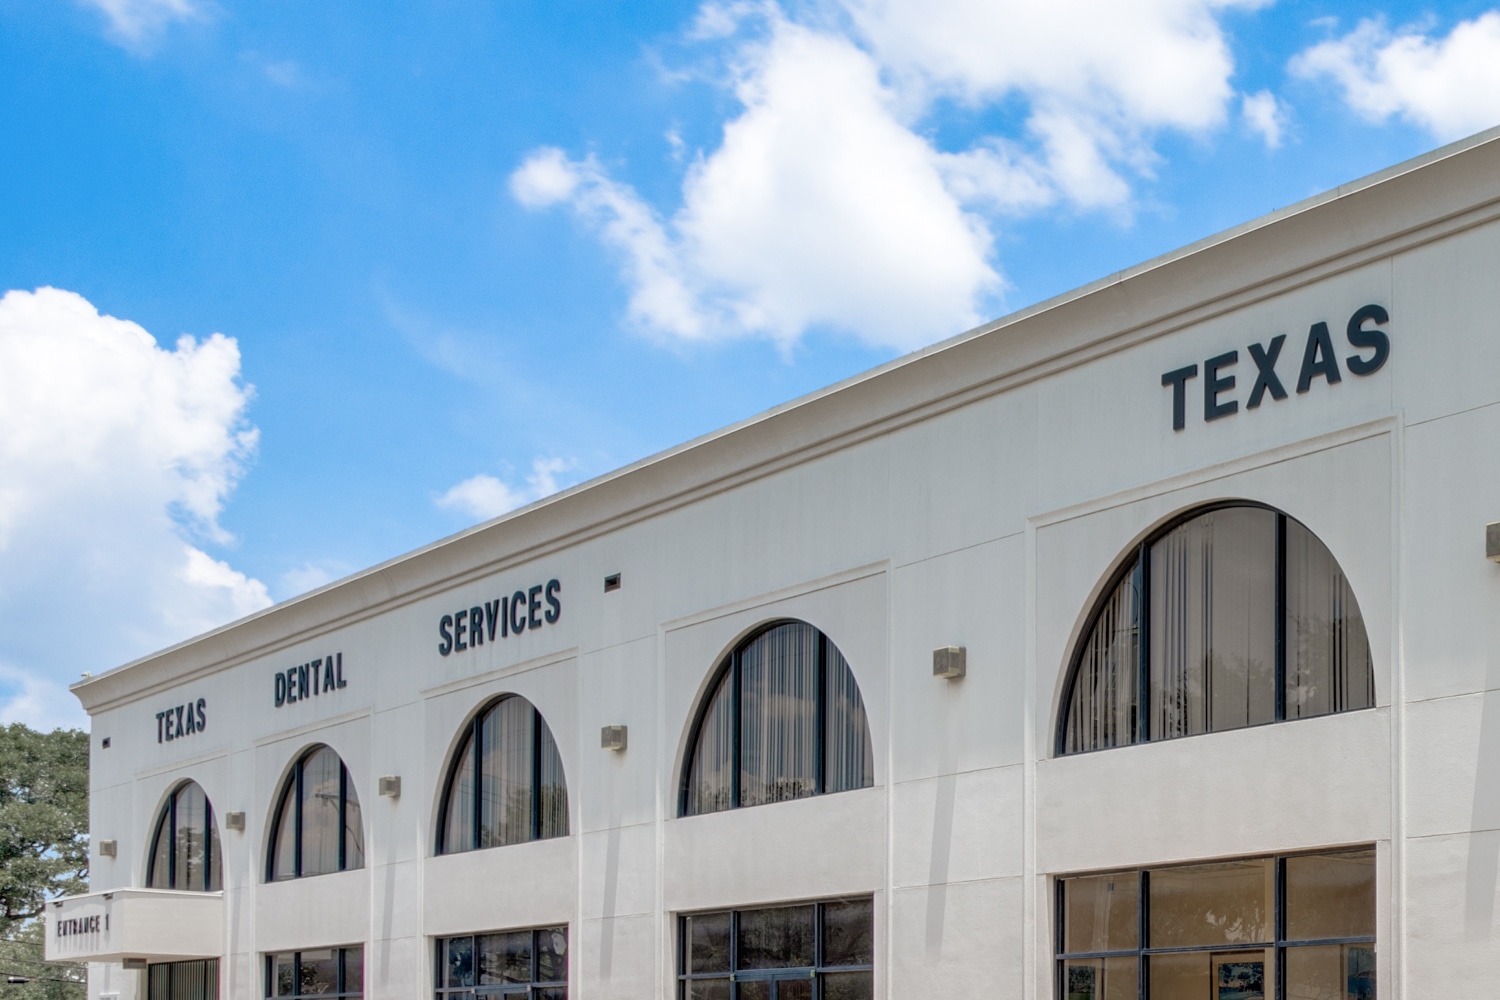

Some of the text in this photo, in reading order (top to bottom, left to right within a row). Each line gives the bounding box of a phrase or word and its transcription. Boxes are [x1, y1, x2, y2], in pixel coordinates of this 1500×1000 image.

[1161, 303, 1391, 432] TEXAS
[155, 578, 563, 744] TEXAS DENTAL SERVICES
[56, 914, 101, 938] ENTRANCE
